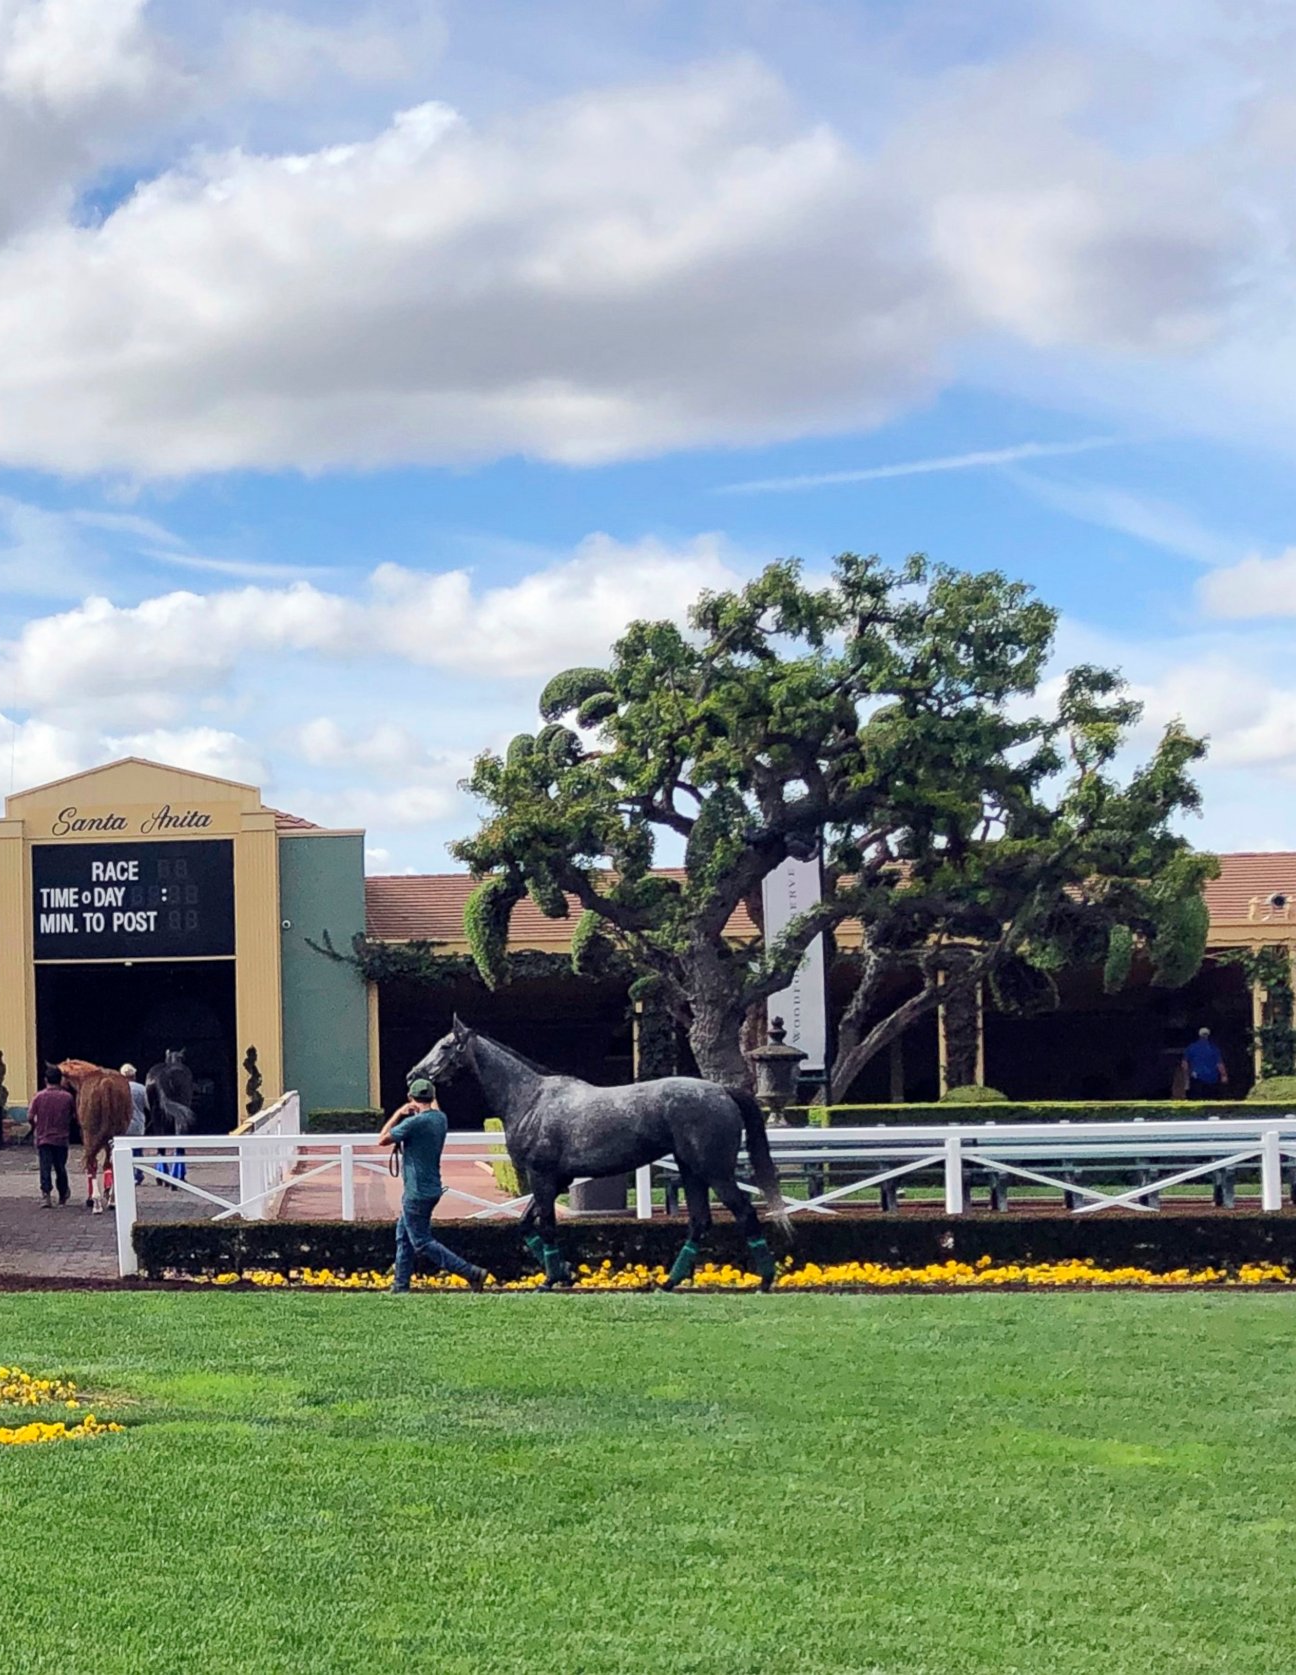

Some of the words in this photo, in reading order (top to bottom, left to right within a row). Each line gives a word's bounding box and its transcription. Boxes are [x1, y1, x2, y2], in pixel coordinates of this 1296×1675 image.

[52, 807, 128, 836] Santa
[141, 805, 212, 833] Anita
[91, 861, 139, 881] RACE
[40, 888, 79, 908] TIME
[94, 886, 126, 907] DAY
[40, 912, 79, 934] MIN.
[83, 912, 105, 932] TO
[113, 911, 157, 932] POST
